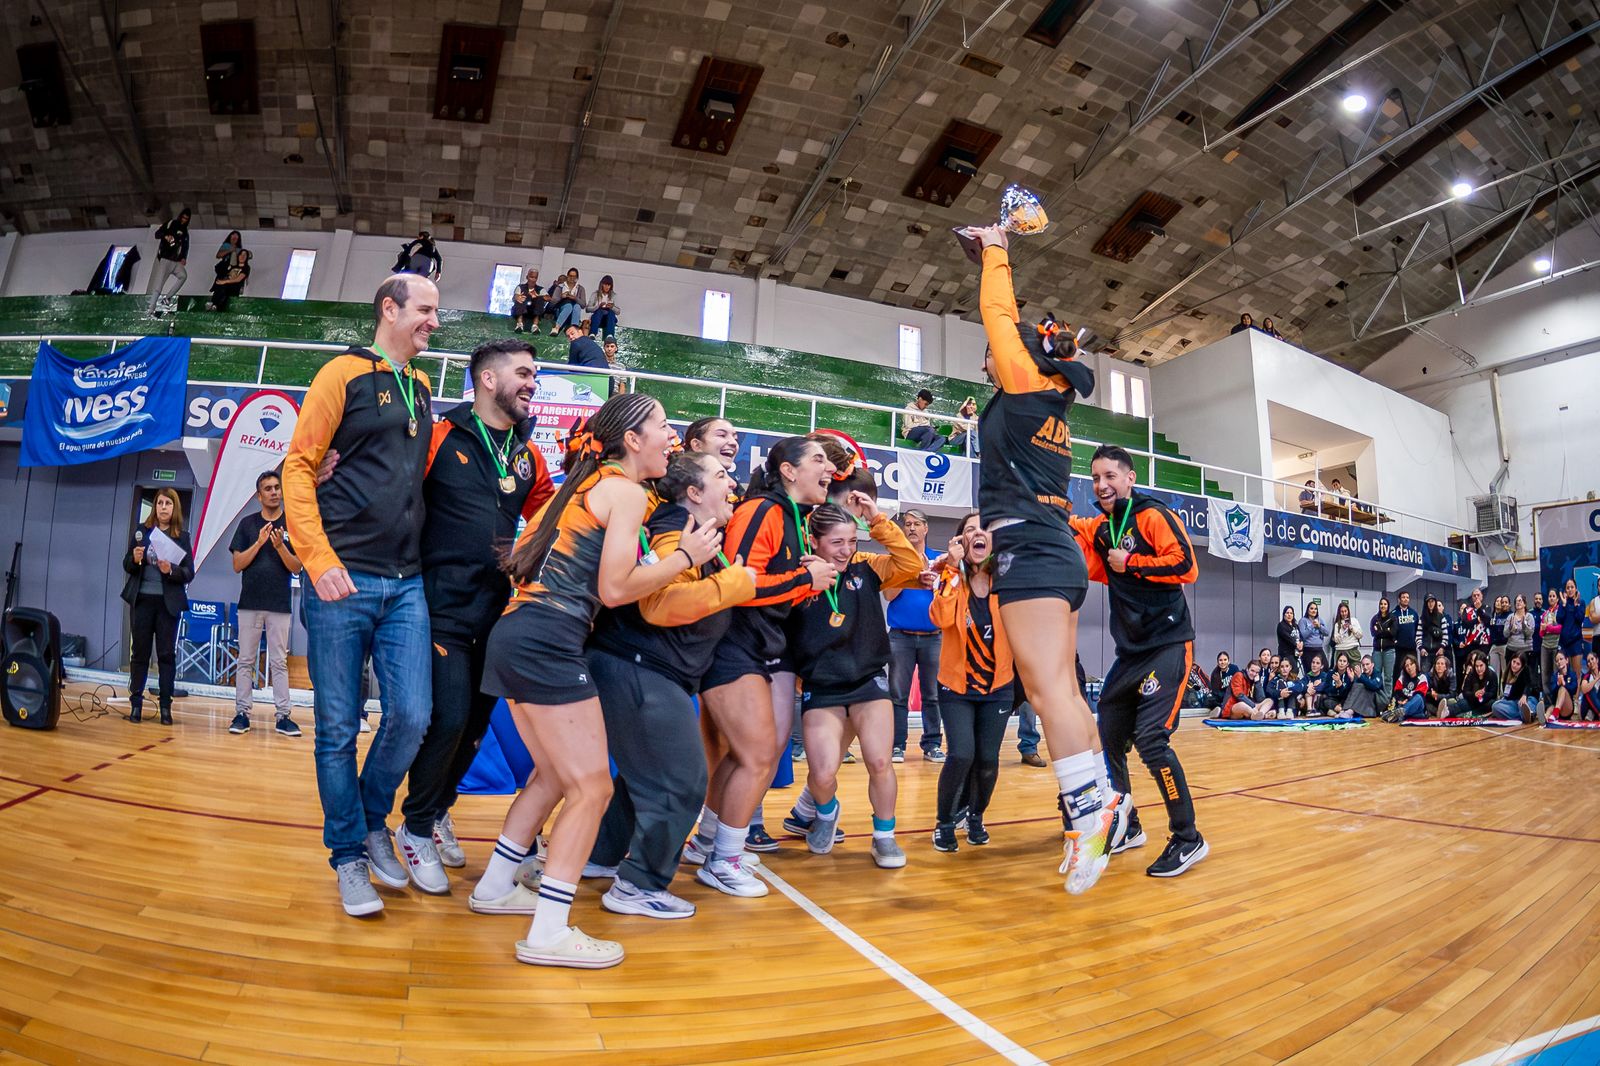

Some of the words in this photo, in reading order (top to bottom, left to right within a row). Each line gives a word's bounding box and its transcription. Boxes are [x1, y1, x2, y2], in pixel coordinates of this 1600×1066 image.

[240, 434, 284, 451] RE/MAX
[923, 482, 945, 494] DIE
[1277, 520, 1296, 541] de
[1300, 524, 1370, 554] Comodoro
[1373, 538, 1423, 565] Rivadavia
